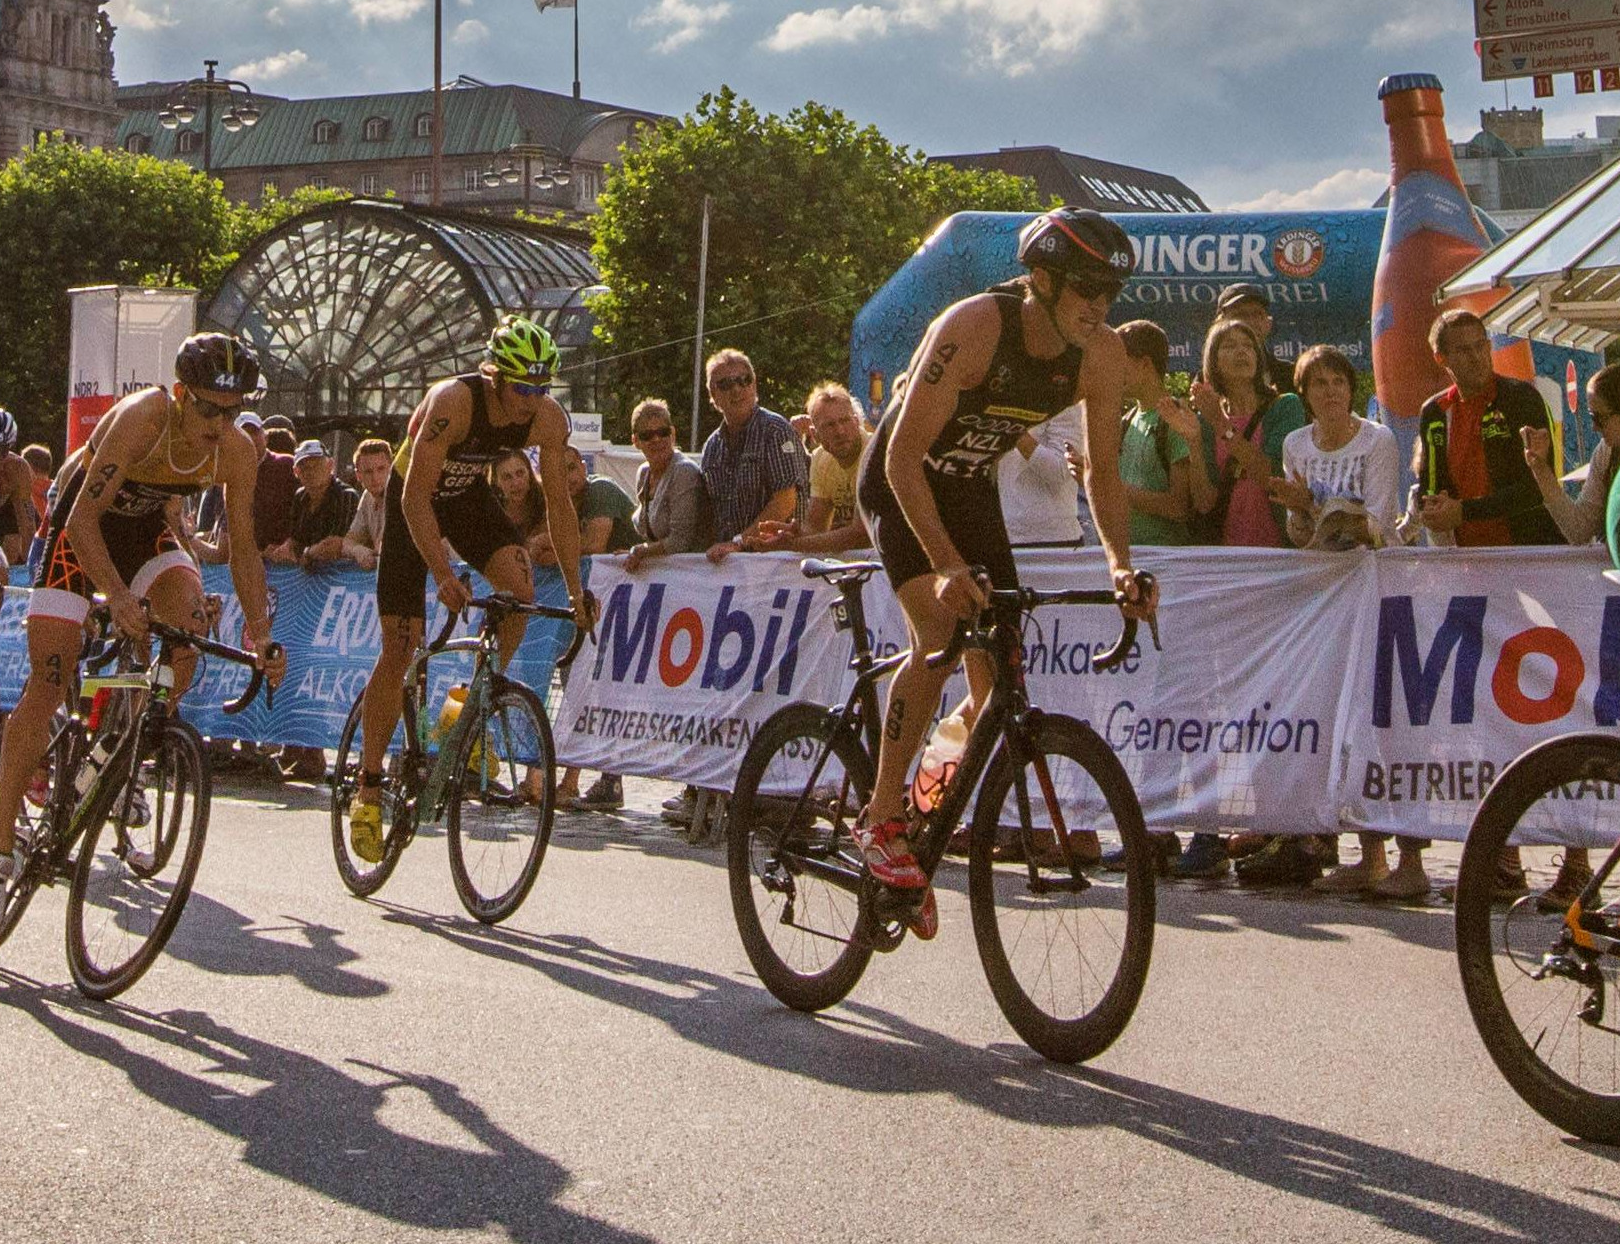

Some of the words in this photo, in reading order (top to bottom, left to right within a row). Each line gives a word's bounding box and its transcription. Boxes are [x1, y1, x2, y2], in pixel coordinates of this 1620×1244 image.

[1505, 9, 1571, 28] Eimsbüttel
[1510, 35, 1595, 55] Wilhelmsburg
[1531, 50, 1611, 70] Landungsbrücken
[1537, 77, 1552, 96] 11
[1577, 72, 1594, 91] 12
[1605, 70, 1617, 89] 2
[1038, 236, 1057, 254] 49
[1109, 251, 1130, 268] 49
[1132, 233, 1273, 278] DINGER
[1117, 282, 1330, 304] KOHOREI
[1273, 340, 1294, 356] all
[528, 364, 544, 375] 47
[923, 342, 959, 386] 49
[214, 373, 235, 388] 44
[956, 430, 1003, 452] NZL
[88, 462, 119, 500] 44
[444, 475, 476, 488] GER
[591, 582, 815, 696] Mobil
[572, 705, 823, 761] BETRIEBSKRANKENSS
[1105, 700, 1321, 754] Generation
